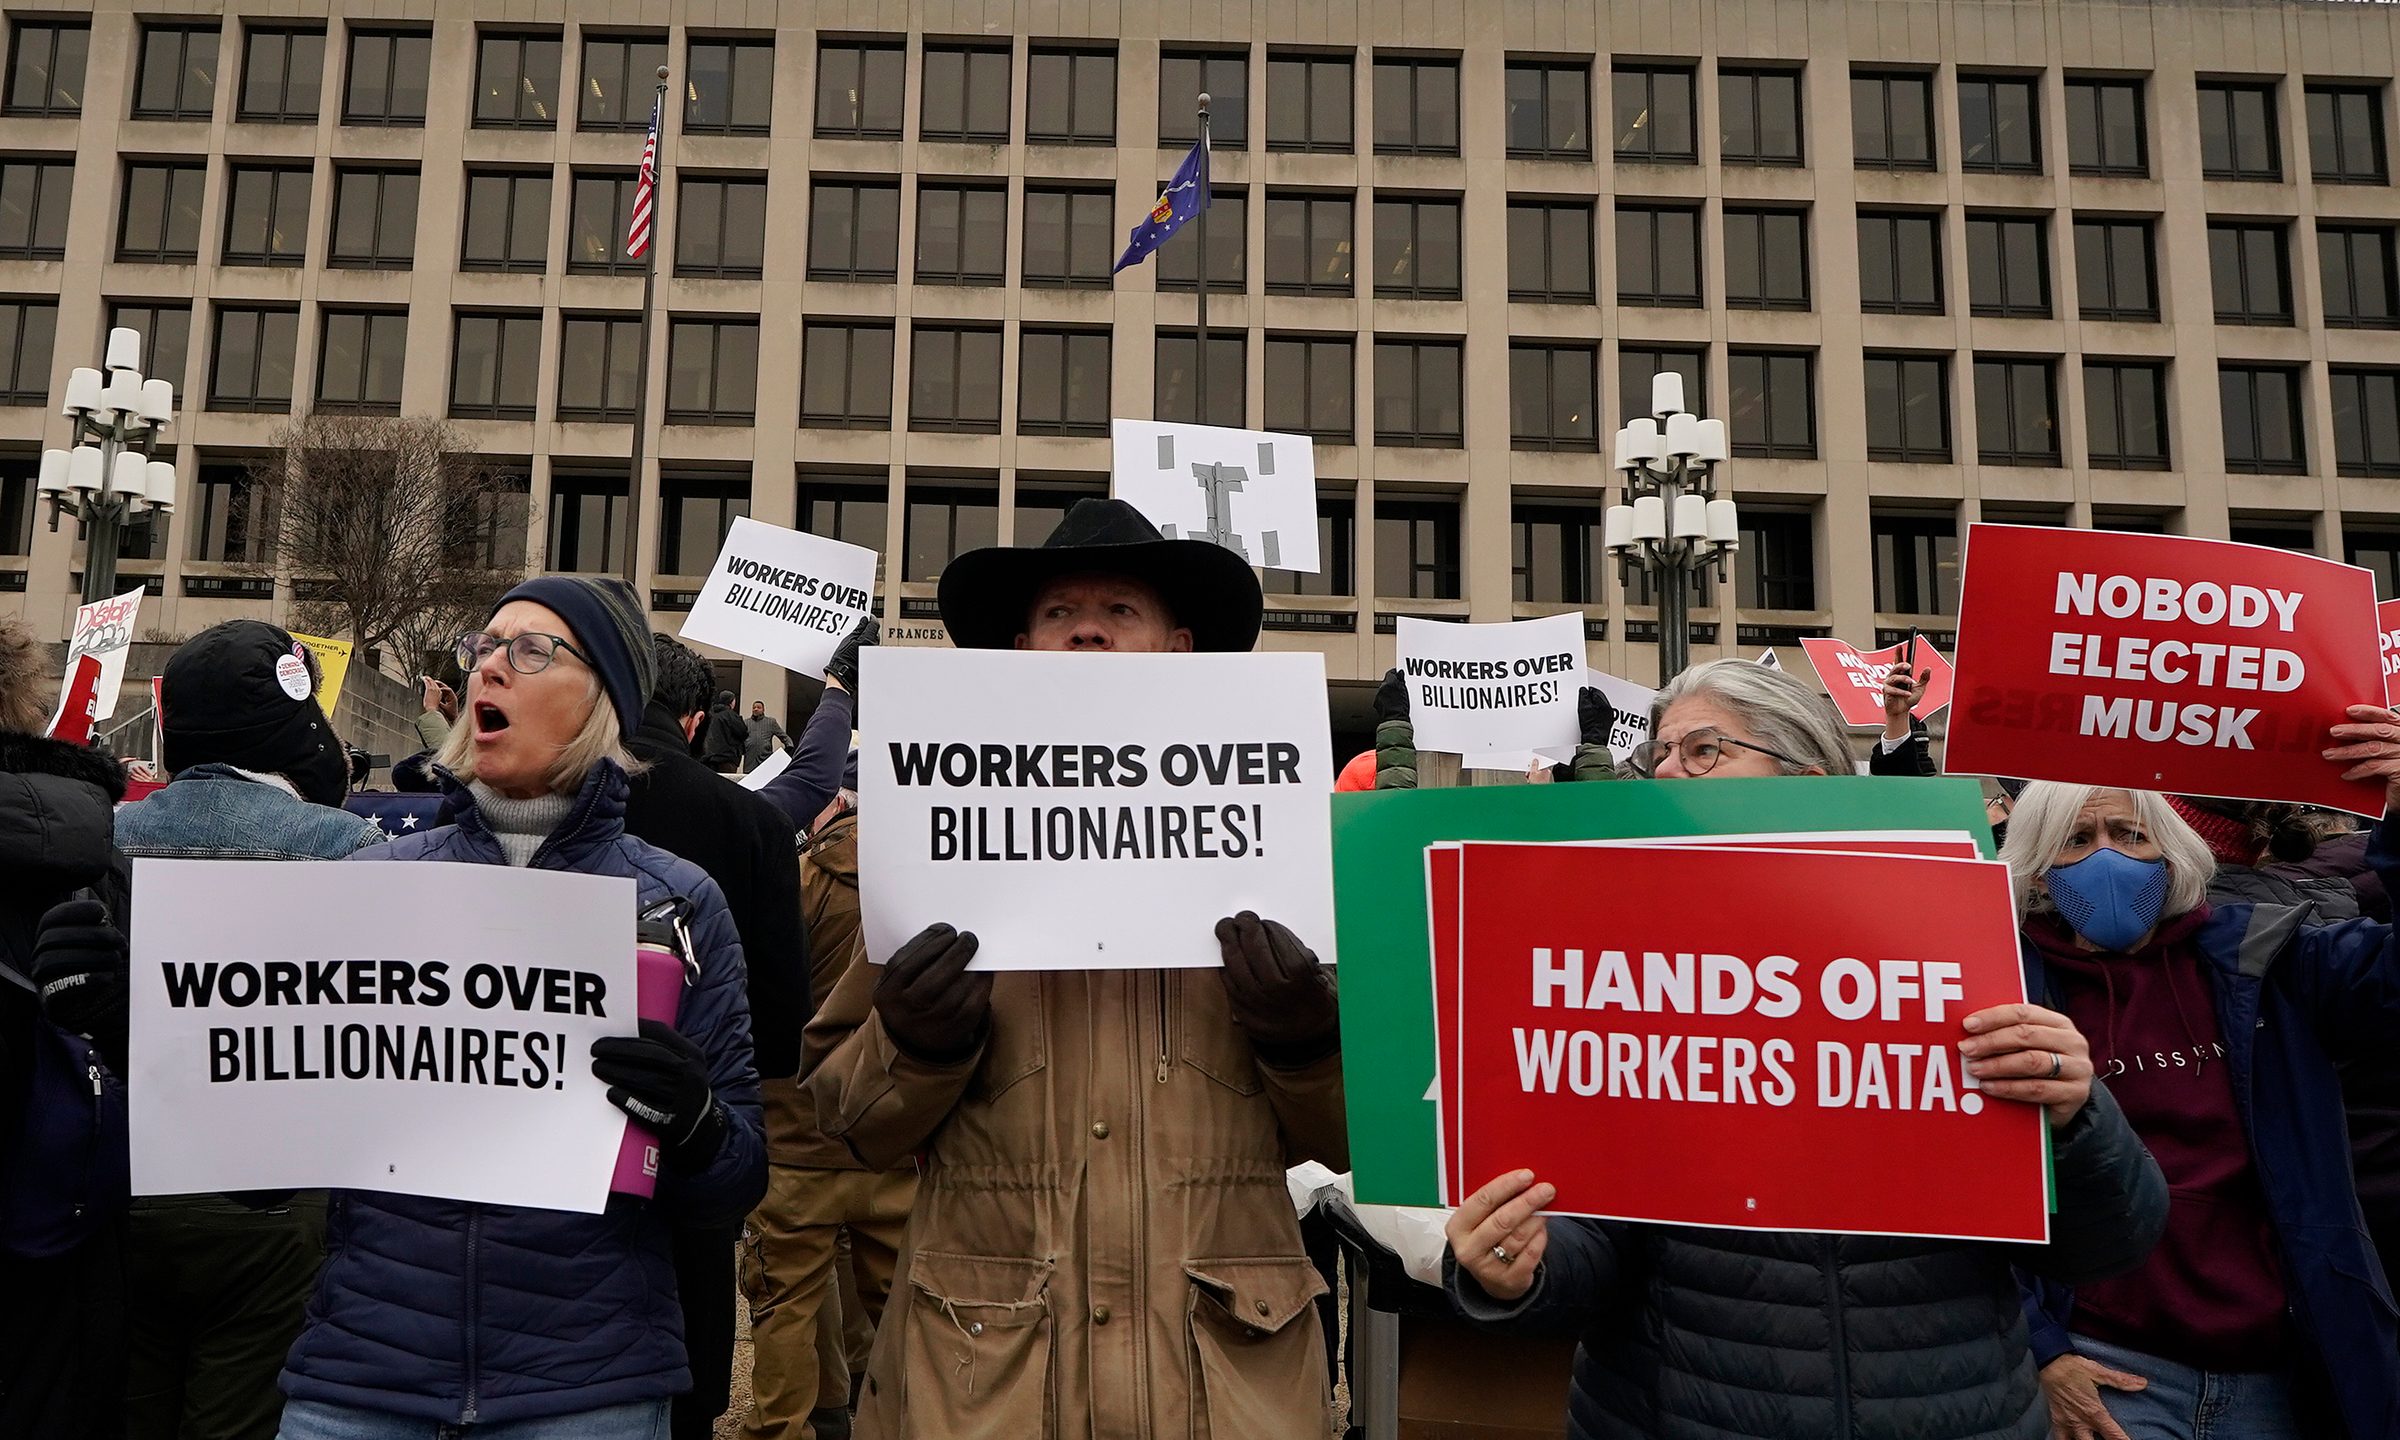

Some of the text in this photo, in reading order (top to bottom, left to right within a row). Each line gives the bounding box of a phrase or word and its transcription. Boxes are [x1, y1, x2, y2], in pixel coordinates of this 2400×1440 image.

[724, 583, 850, 637] BILLIONAIRES!
[726, 555, 868, 612] WORKERS OVER
[2053, 572, 2304, 632] NOBODY
[888, 627, 944, 640] FRANCES
[2049, 631, 2305, 692] ELECTED
[1405, 652, 1574, 680] WORKERS OVER
[1421, 680, 1559, 710] BILLIONAIRES!
[2079, 695, 2261, 750] MUSK
[889, 743, 1302, 787] WORKERS OVER
[931, 804, 1263, 861] BILLIONAIRES!
[162, 960, 607, 1018] WORKERS OVER
[1533, 948, 1963, 1022] HANDS OFF
[209, 1023, 566, 1090] BILLIONAIRES!
[1512, 1028, 1796, 1107] WORKERS
